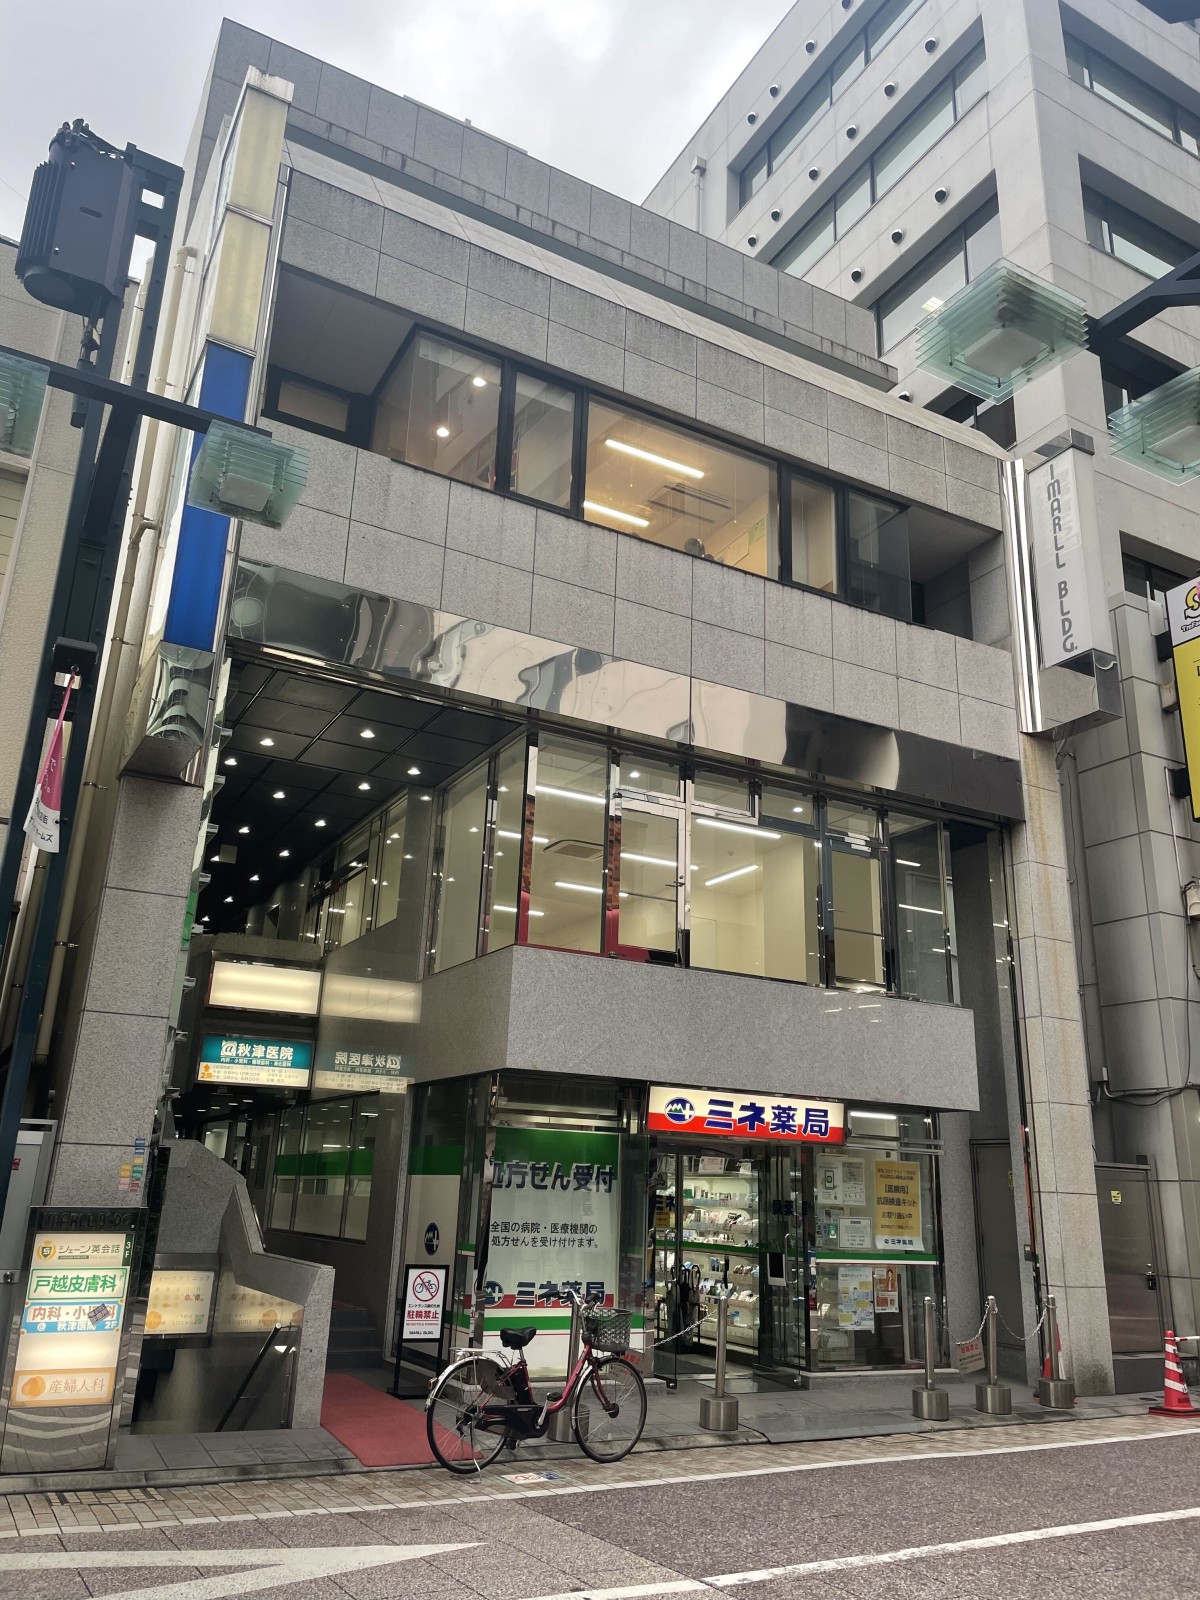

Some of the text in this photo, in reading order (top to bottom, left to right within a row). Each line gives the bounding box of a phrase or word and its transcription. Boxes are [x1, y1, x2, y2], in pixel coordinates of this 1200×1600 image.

[1047, 464, 1078, 653] IMARLL BLDG.
[704, 1098, 830, 1137] ミネ薬局
[490, 1221, 598, 1235] 全国の病院・医療機関の
[58, 1244, 121, 1254] シェーン英会話
[491, 1236, 599, 1249] 処方せんを受け付けます。
[34, 1274, 117, 1293] 戸越皮膚科
[32, 1305, 115, 1321] 内科・小科
[407, 1310, 439, 1319] 駐輪禁止
[104, 1321, 117, 1330] 2F
[48, 1378, 105, 1394] 産婦人科
